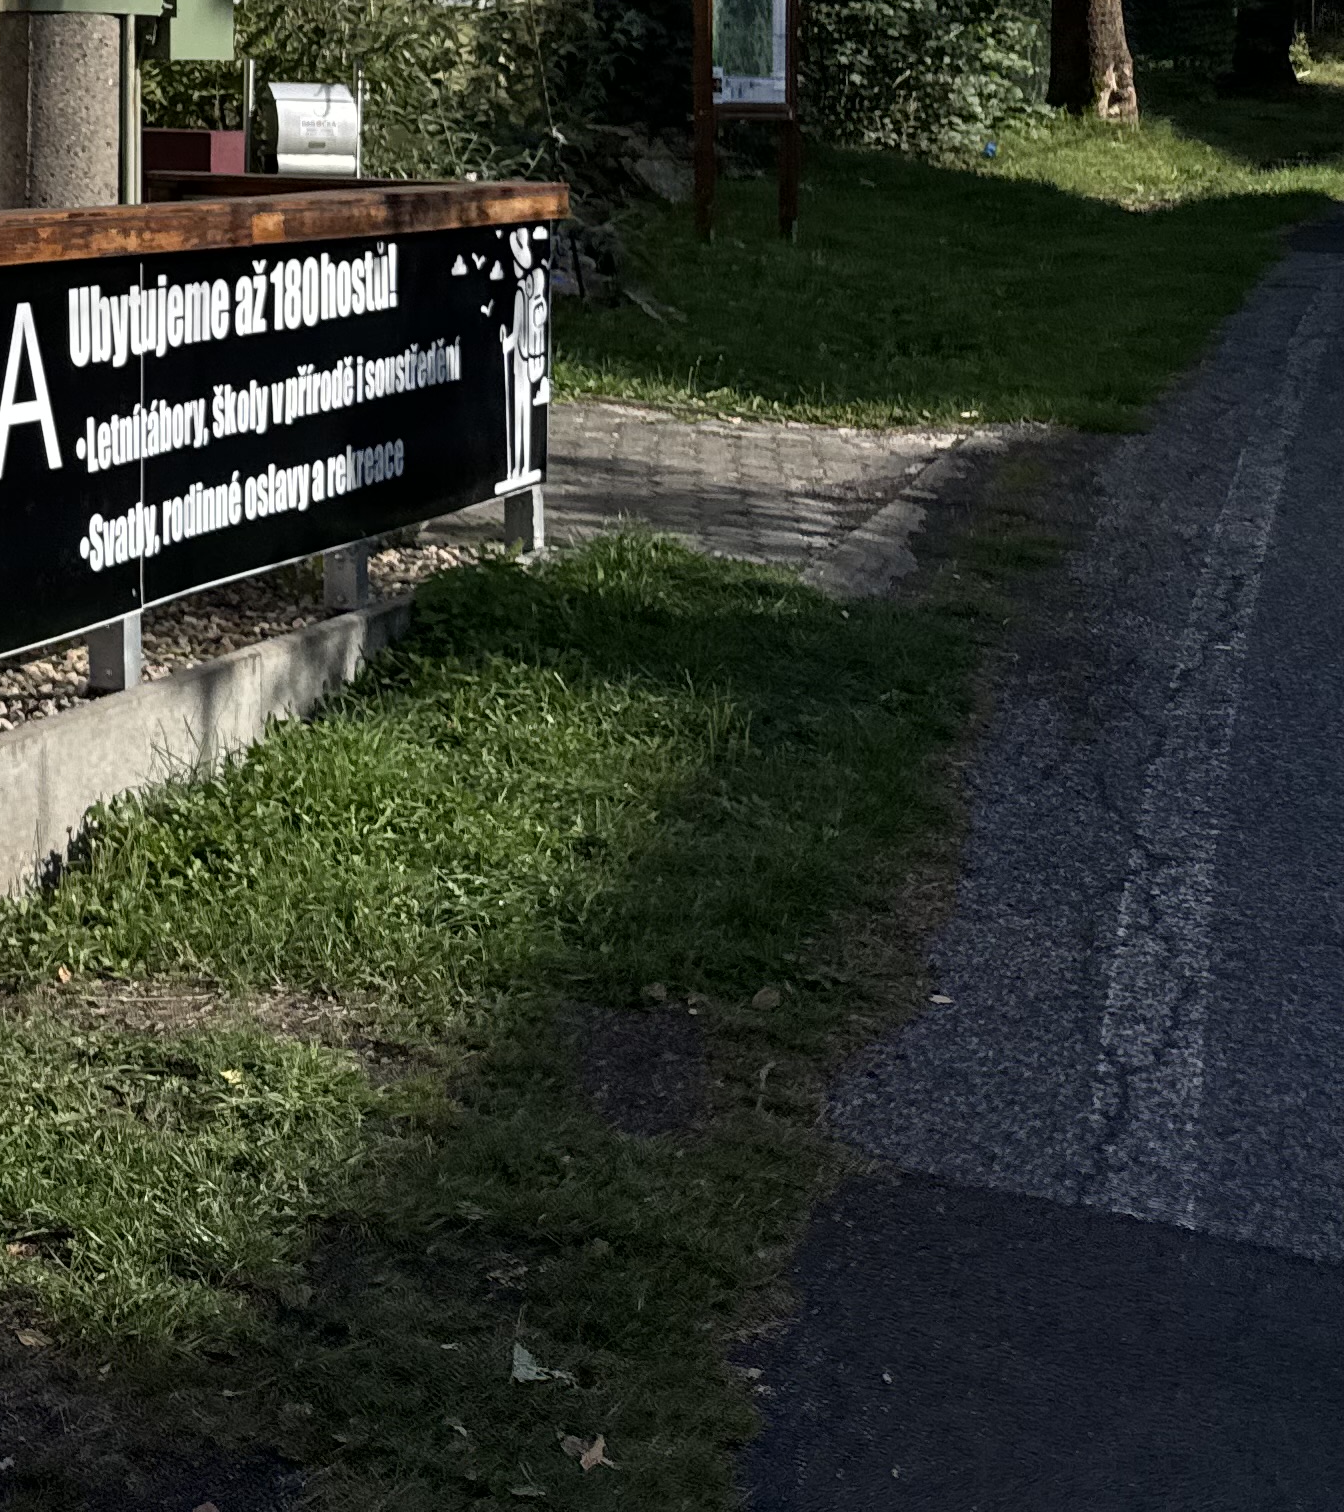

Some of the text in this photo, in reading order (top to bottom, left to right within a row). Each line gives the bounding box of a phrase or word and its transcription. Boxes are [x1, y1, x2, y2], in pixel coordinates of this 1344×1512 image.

[68, 240, 398, 368] Ubytujeme až 180 hostů!
[212, 378, 269, 439] školy
[162, 469, 243, 546] rodinné
[244, 462, 310, 522] oslavy
[312, 460, 325, 503] a
[326, 438, 404, 499] rekreace
